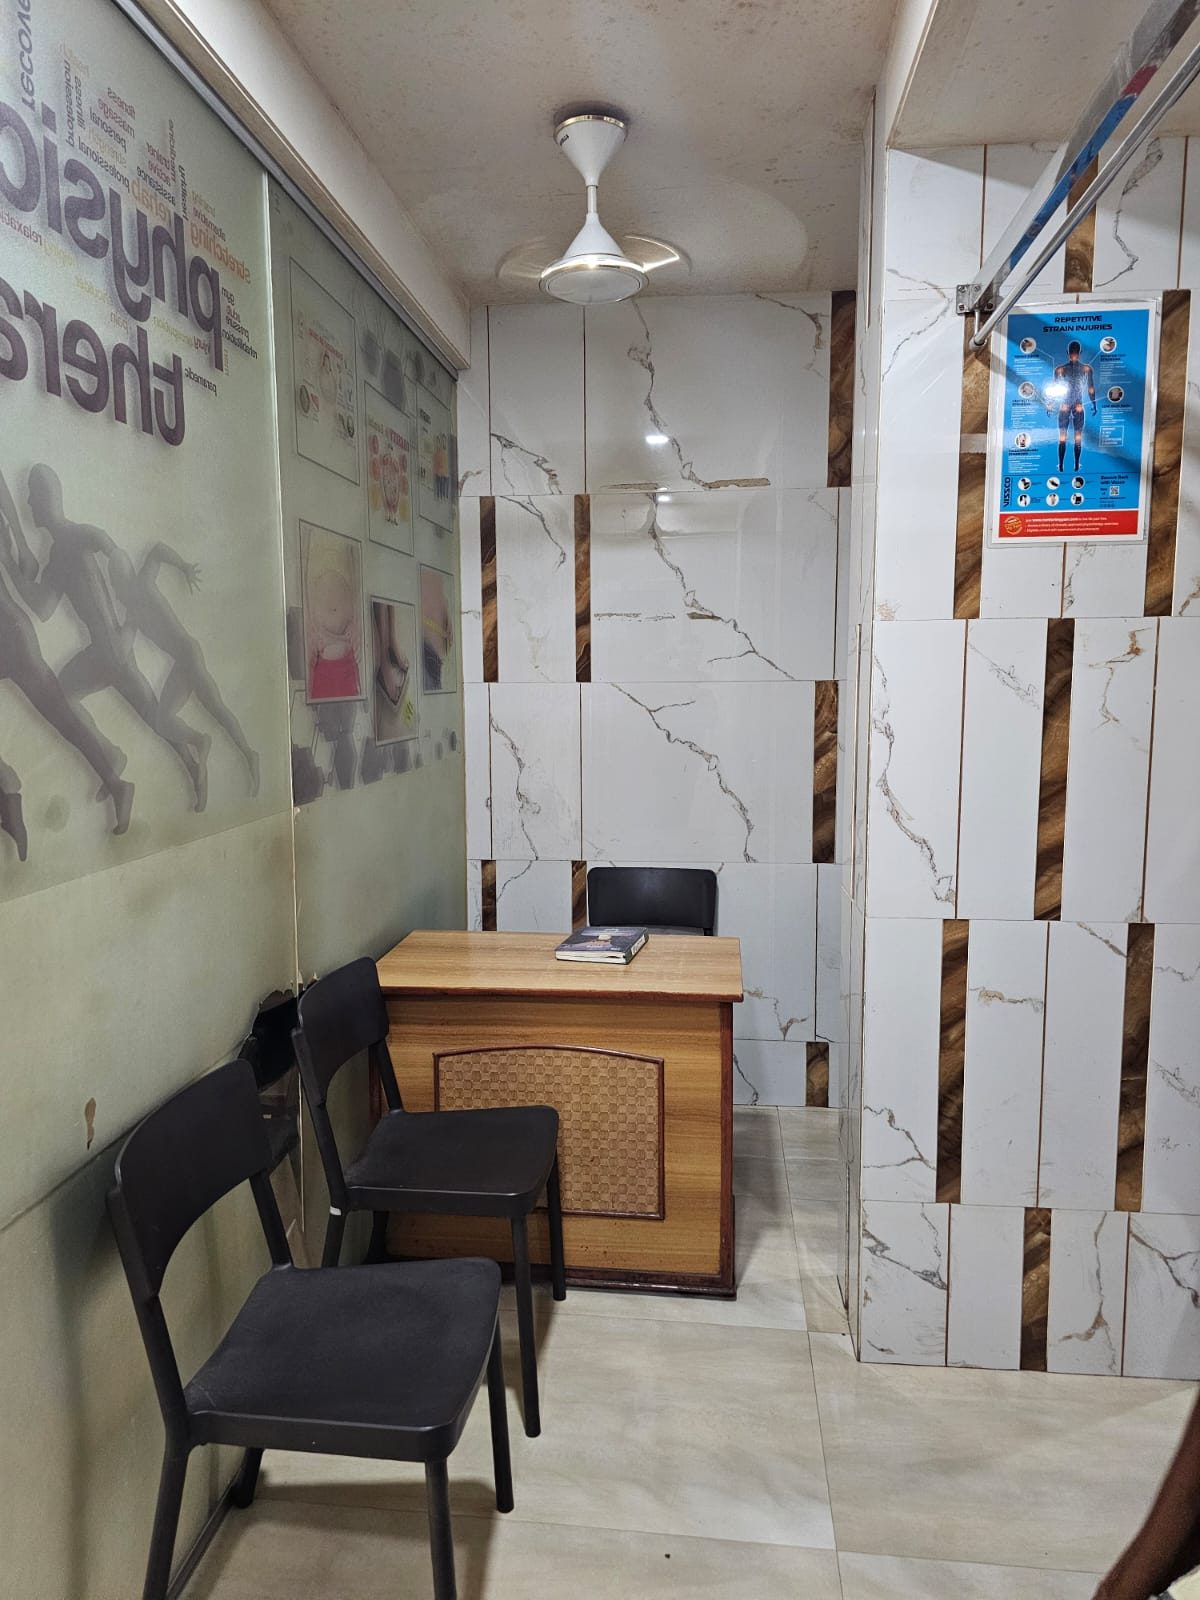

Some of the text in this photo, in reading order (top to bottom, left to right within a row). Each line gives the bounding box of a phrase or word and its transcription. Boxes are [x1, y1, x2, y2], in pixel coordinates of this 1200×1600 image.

[1055, 315, 1102, 323] REPETITIVE
[1043, 325, 1074, 333] STRAIN
[1003, 477, 1011, 507] VISSCO
